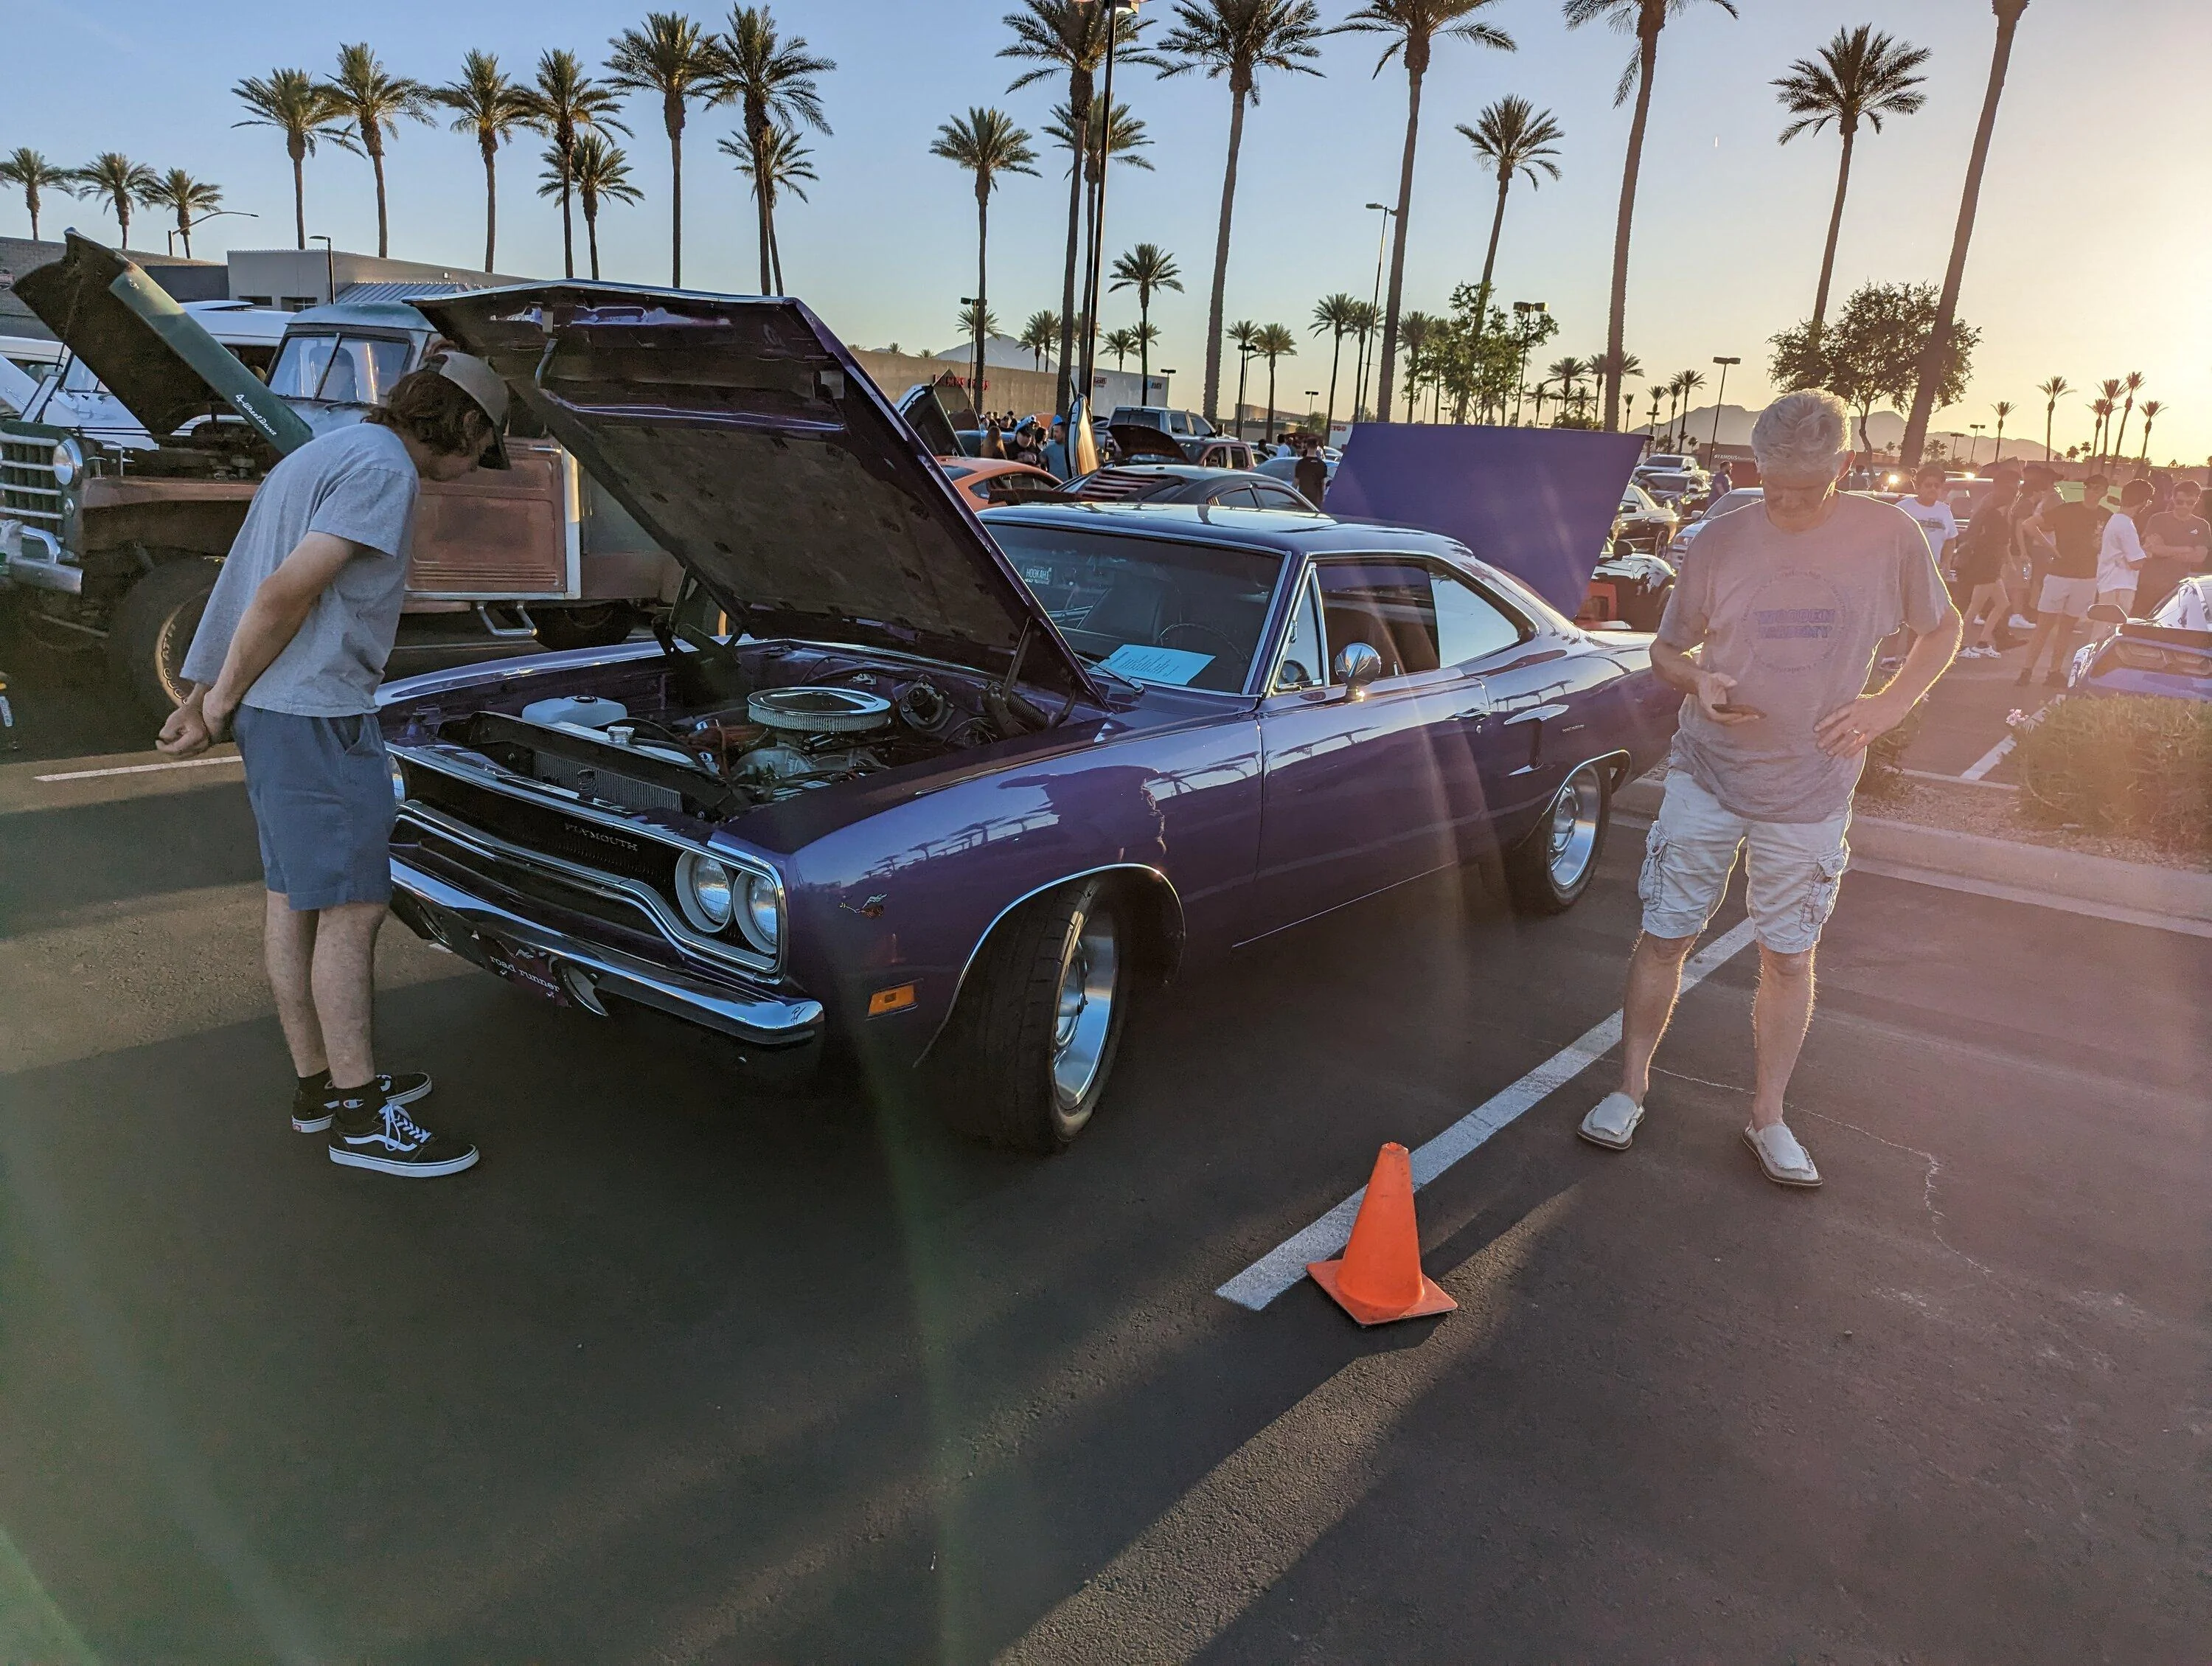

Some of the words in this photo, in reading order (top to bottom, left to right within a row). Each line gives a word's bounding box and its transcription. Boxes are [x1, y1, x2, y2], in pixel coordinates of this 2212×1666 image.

[259, 417, 277, 437] Drive
[564, 822, 638, 852] PLYMOUTH
[490, 955, 517, 973] road
[518, 968, 560, 993] runner
